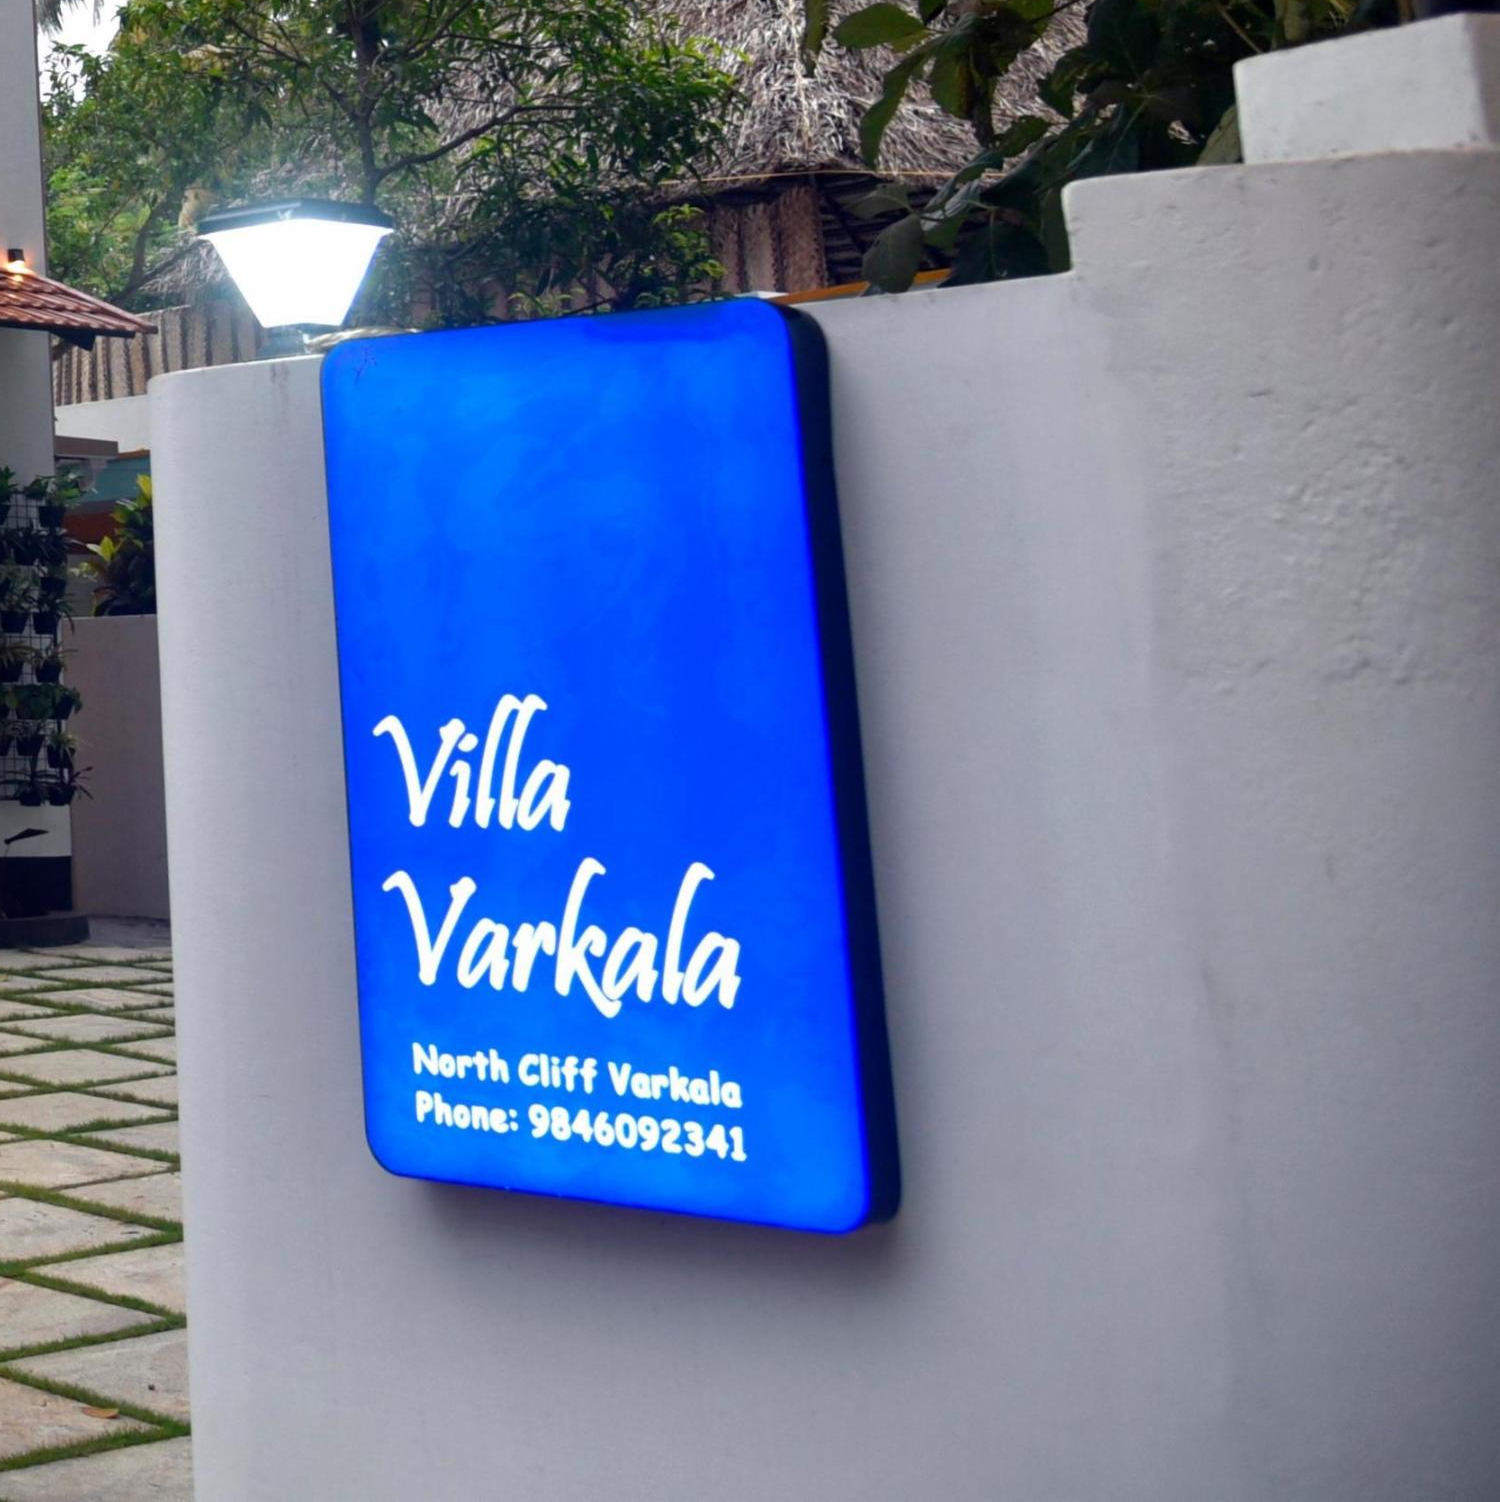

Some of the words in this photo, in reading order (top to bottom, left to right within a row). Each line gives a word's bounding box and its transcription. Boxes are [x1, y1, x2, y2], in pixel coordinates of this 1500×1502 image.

[372, 693, 571, 832] Villa
[381, 857, 742, 1019] Varkala
[412, 1042, 510, 1084] North
[517, 1053, 598, 1094] Cliff
[607, 1061, 743, 1109] Varkala
[415, 1090, 519, 1134] Phone:
[527, 1103, 747, 1162] 9846092341
